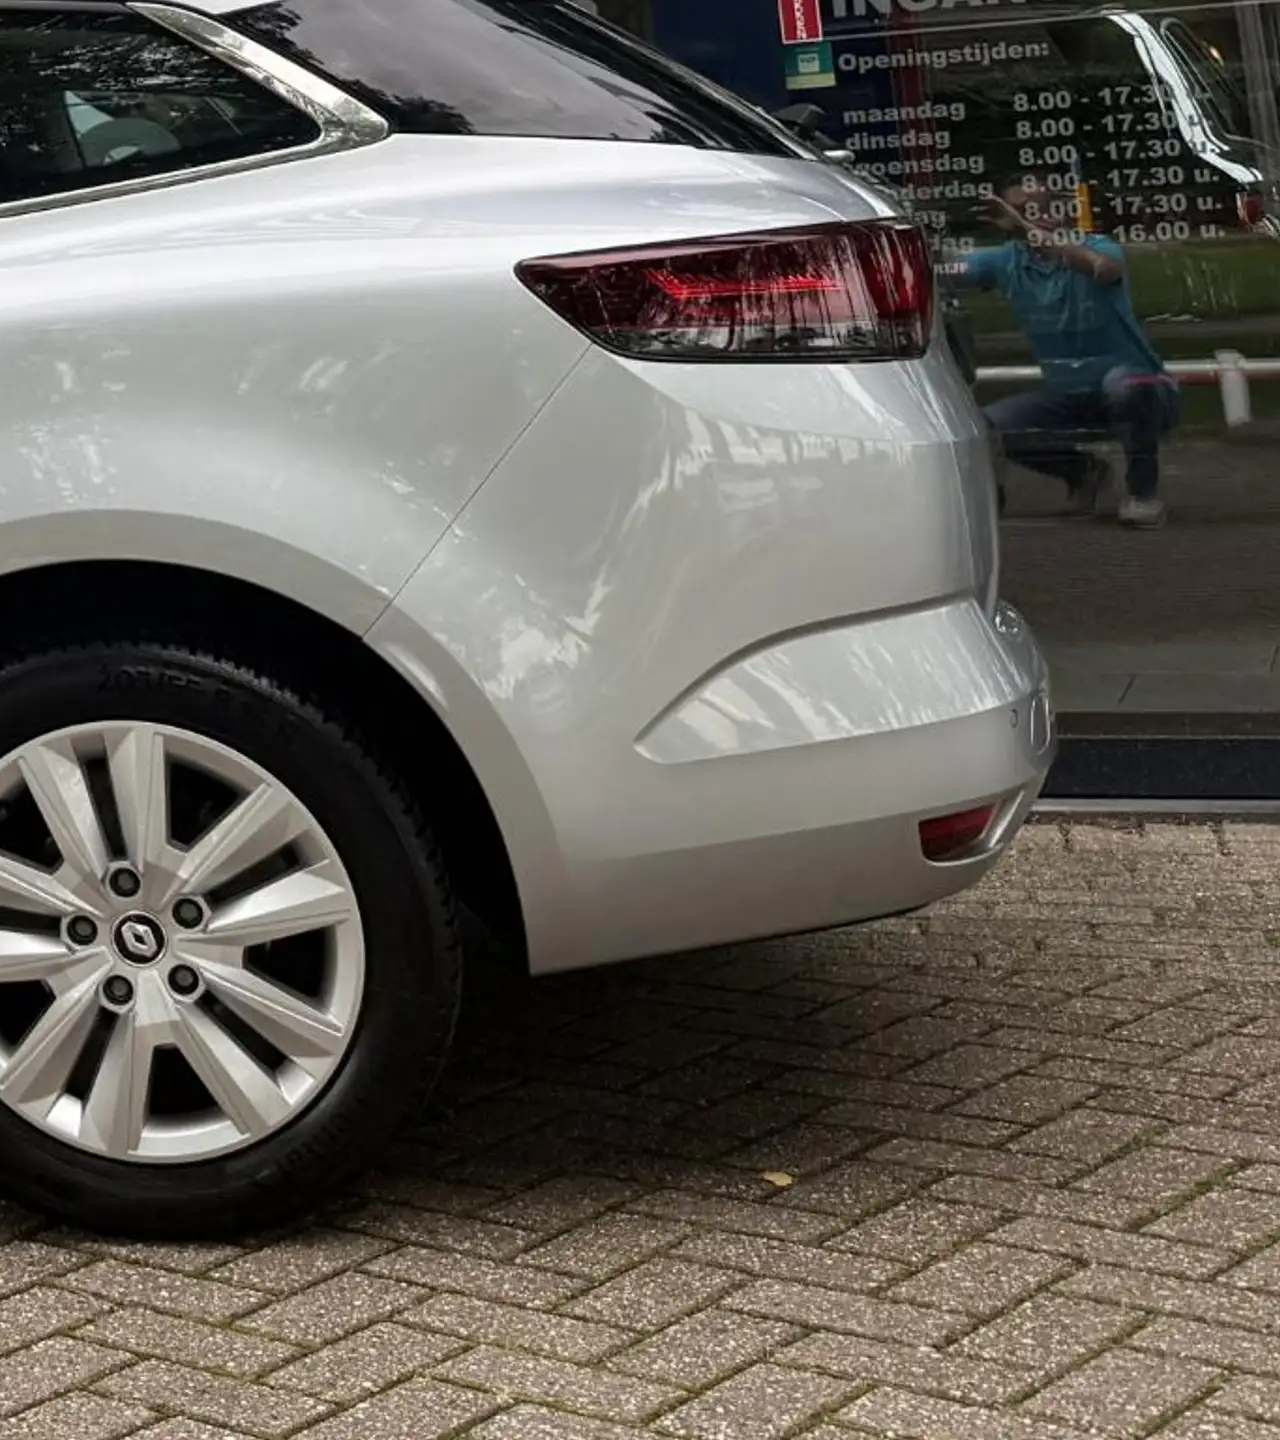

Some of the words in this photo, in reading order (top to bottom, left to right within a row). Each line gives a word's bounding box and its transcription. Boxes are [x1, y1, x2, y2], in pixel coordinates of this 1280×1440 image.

[838, 40, 1050, 74] Openingstijden:
[843, 101, 966, 126] maandag
[1013, 91, 1072, 112] 8.00
[1097, 85, 1173, 107] 17.30
[845, 130, 951, 151] dinsdag
[1016, 118, 1075, 140] 8.00
[1101, 112, 1178, 134] 17.30
[1019, 145, 1078, 167] 8.00
[1104, 139, 1182, 160] 17.30
[894, 180, 994, 201] derdag
[1021, 172, 1081, 193] 8.00
[1106, 166, 1185, 188] 17.30
[1194, 167, 1221, 184] u.
[1024, 199, 1083, 221] 8.00
[1110, 193, 1188, 216] 17.30
[1197, 195, 1224, 210] u.
[1027, 227, 1087, 248] 9.00
[1112, 221, 1191, 244] 16.00
[1199, 223, 1227, 239] u.
